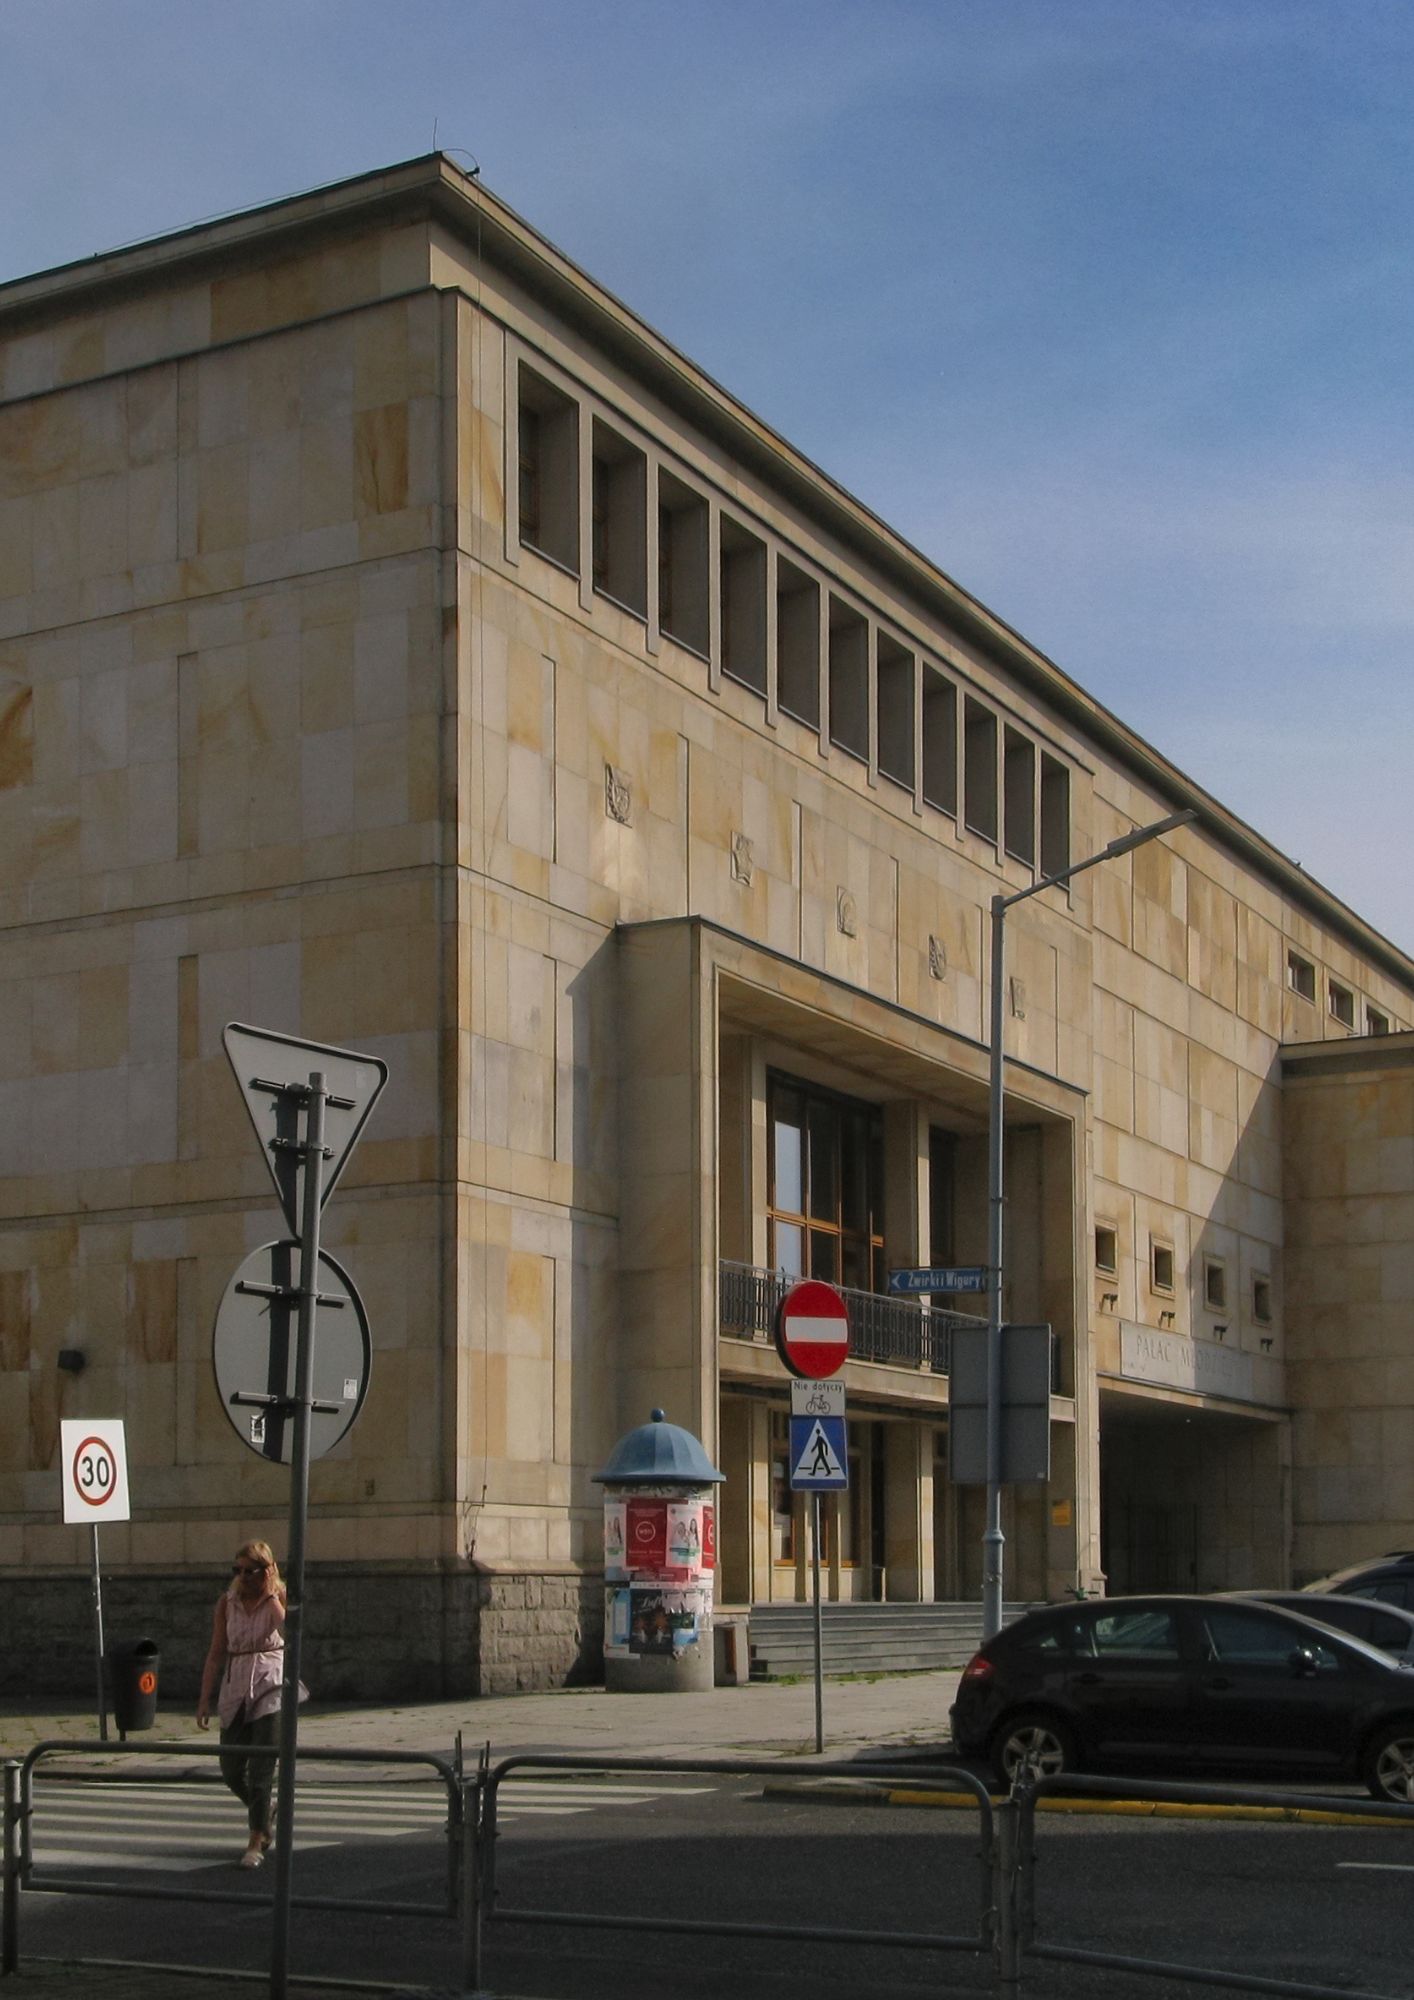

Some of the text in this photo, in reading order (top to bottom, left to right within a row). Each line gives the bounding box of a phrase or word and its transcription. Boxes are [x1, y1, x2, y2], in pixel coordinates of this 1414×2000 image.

[946, 1271, 981, 1289] Wigury
[794, 1381, 843, 1393] Nie dotyczy
[81, 1456, 109, 1487] 30
